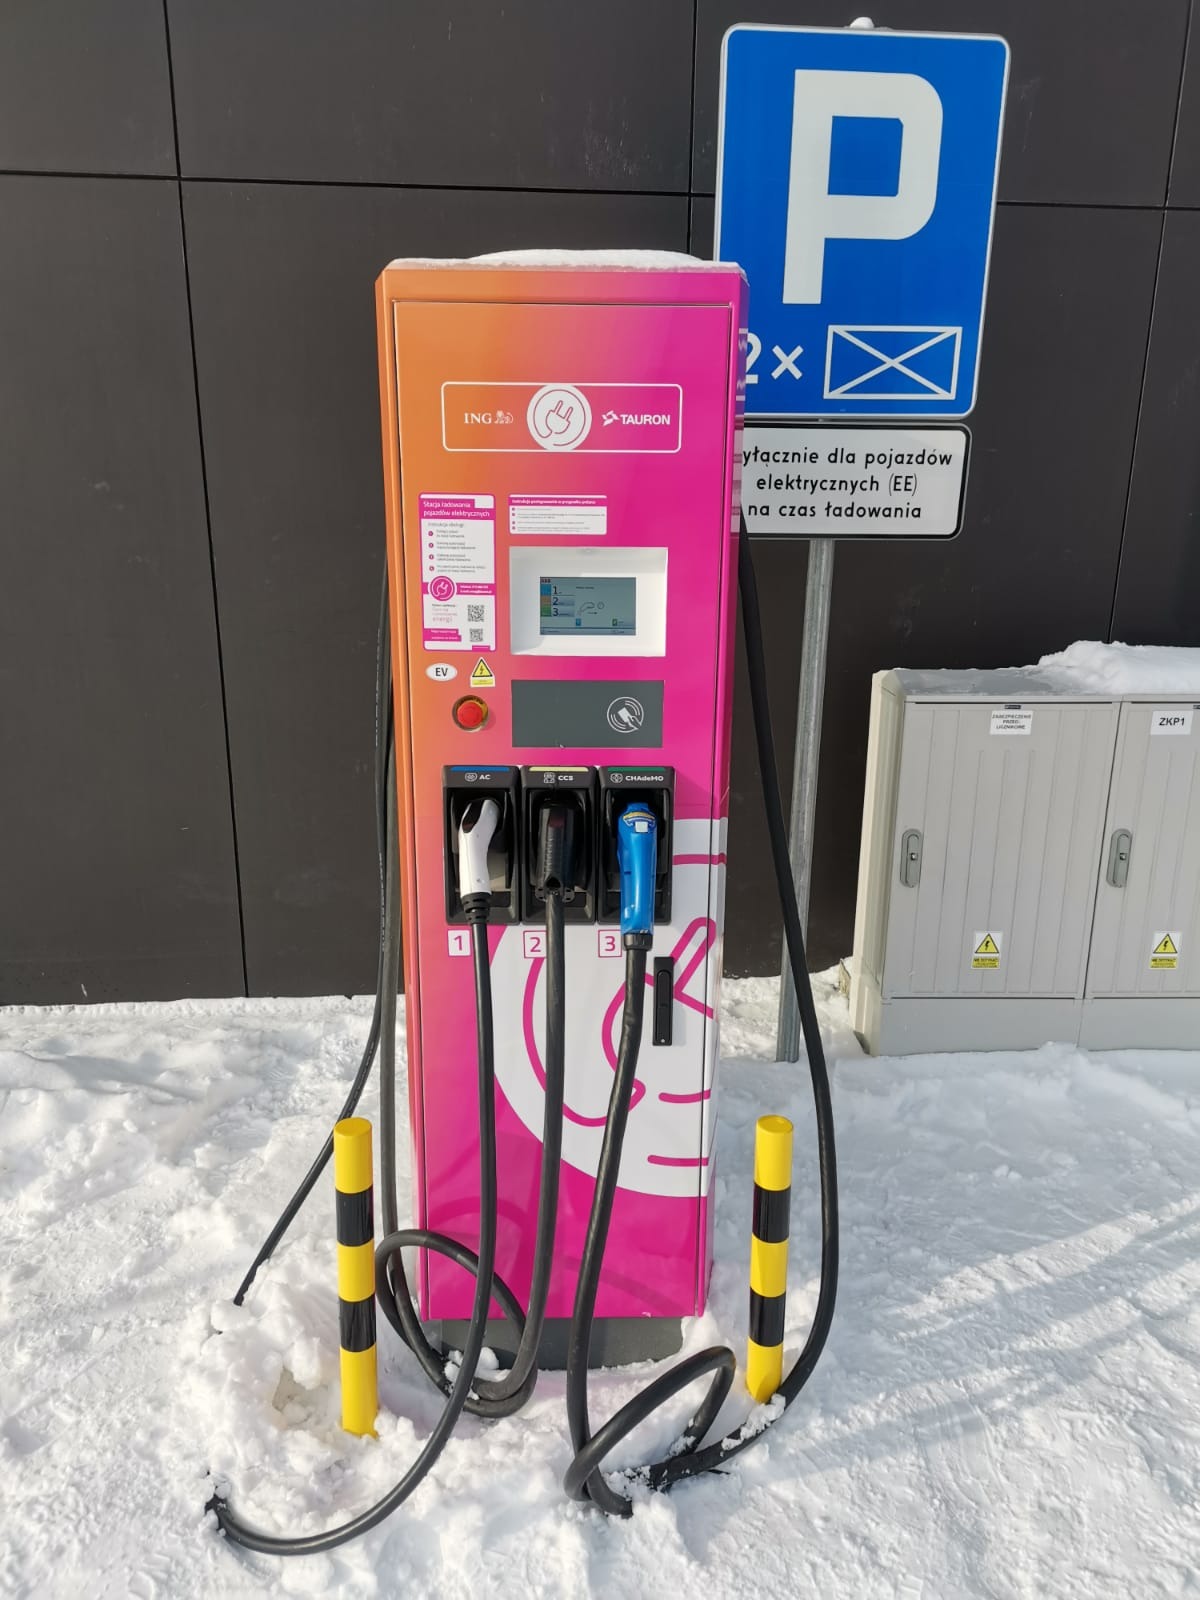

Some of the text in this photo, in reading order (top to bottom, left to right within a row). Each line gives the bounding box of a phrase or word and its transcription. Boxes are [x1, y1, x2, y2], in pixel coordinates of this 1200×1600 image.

[783, 69, 943, 304] P
[464, 412, 492, 425] ING
[620, 413, 671, 426] TAURON
[742, 446, 953, 470] yłącznie dla pojazdów
[756, 473, 918, 497] elektrycznych (EE)
[748, 501, 922, 519] na czas ładowania
[552, 585, 558, 595] 1
[552, 597, 559, 606] 2
[552, 607, 559, 617] 3
[435, 667, 449, 677] EV
[1158, 717, 1185, 727] ZKP1
[625, 774, 664, 782] CHAdeMO
[453, 935, 464, 952] 1
[530, 937, 542, 953] 2
[604, 935, 616, 951] 3
